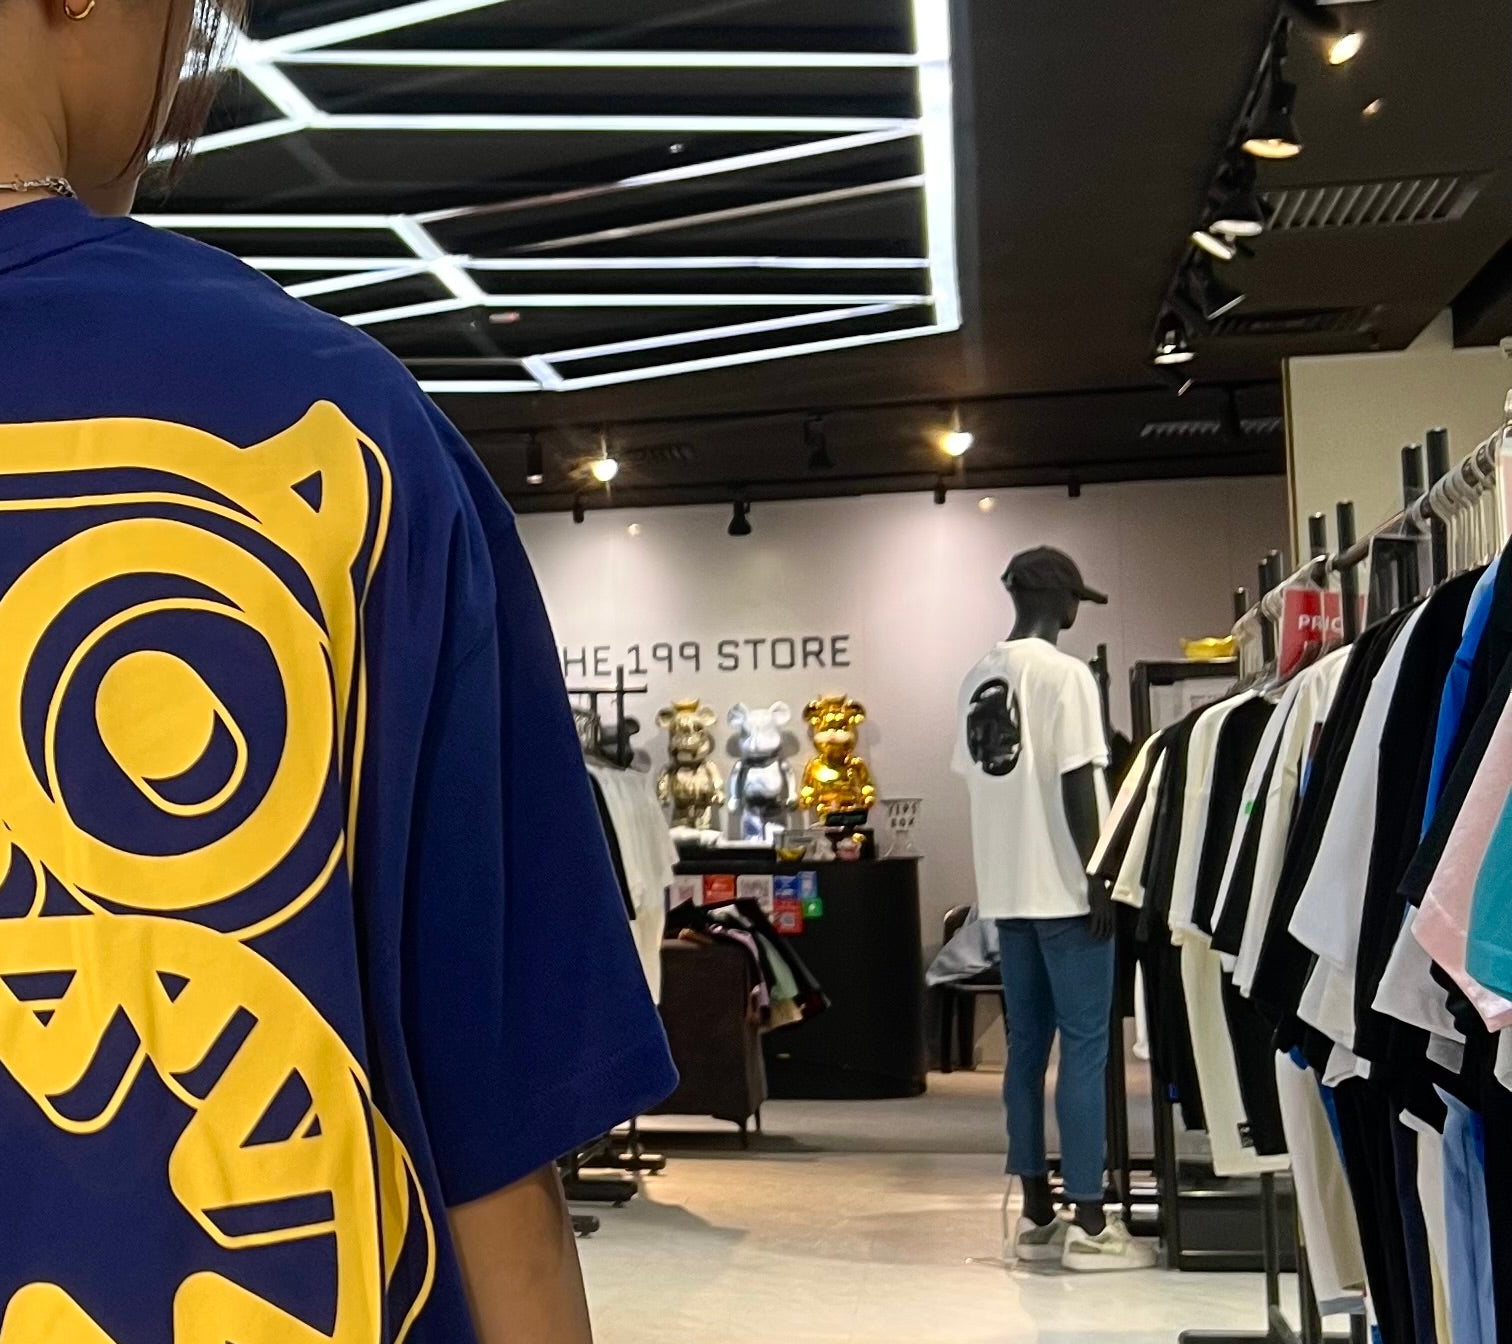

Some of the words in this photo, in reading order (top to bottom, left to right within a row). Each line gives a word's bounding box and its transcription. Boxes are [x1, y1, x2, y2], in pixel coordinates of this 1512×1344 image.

[1298, 614, 1344, 633] PRIC
[562, 645, 612, 677] HE
[627, 642, 701, 675] 199
[717, 635, 851, 672] STORE
